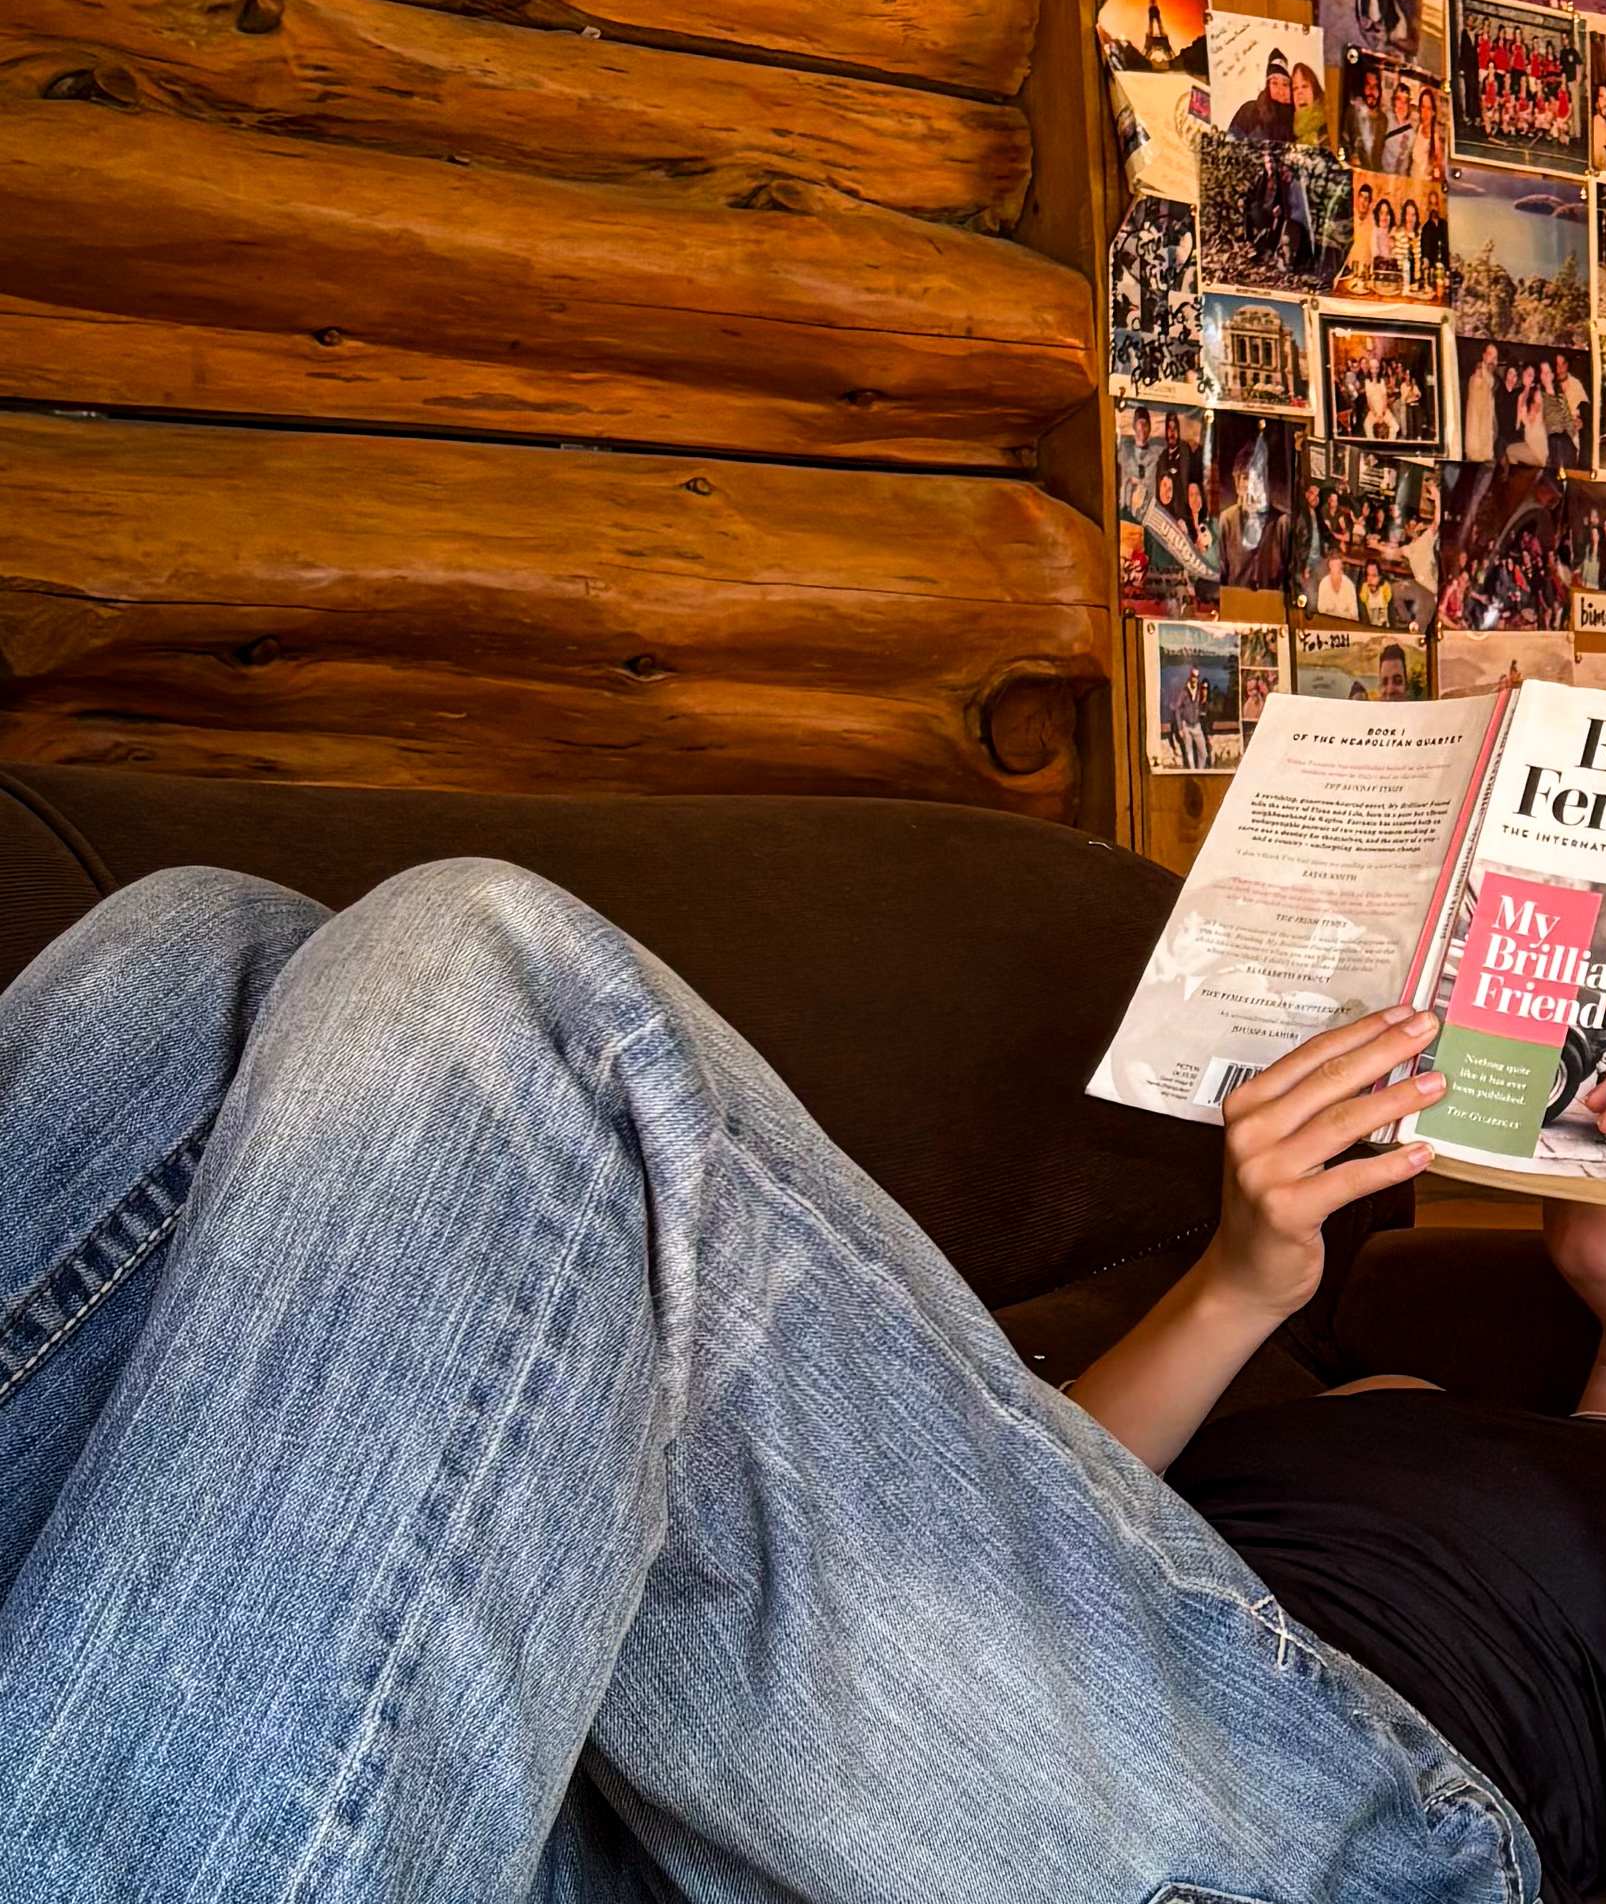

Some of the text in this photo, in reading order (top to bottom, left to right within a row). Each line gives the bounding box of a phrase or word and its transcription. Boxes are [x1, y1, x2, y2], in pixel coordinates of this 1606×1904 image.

[1293, 733, 1464, 747] OF THE NEAPOLITAN QUARTET
[1367, 727, 1396, 736] BOOK
[1502, 824, 1529, 838] THE
[1492, 894, 1561, 948] My
[1465, 1053, 1505, 1072] Nothing
[1460, 1067, 1527, 1090] like it has ever
[1476, 1088, 1527, 1105] published.
